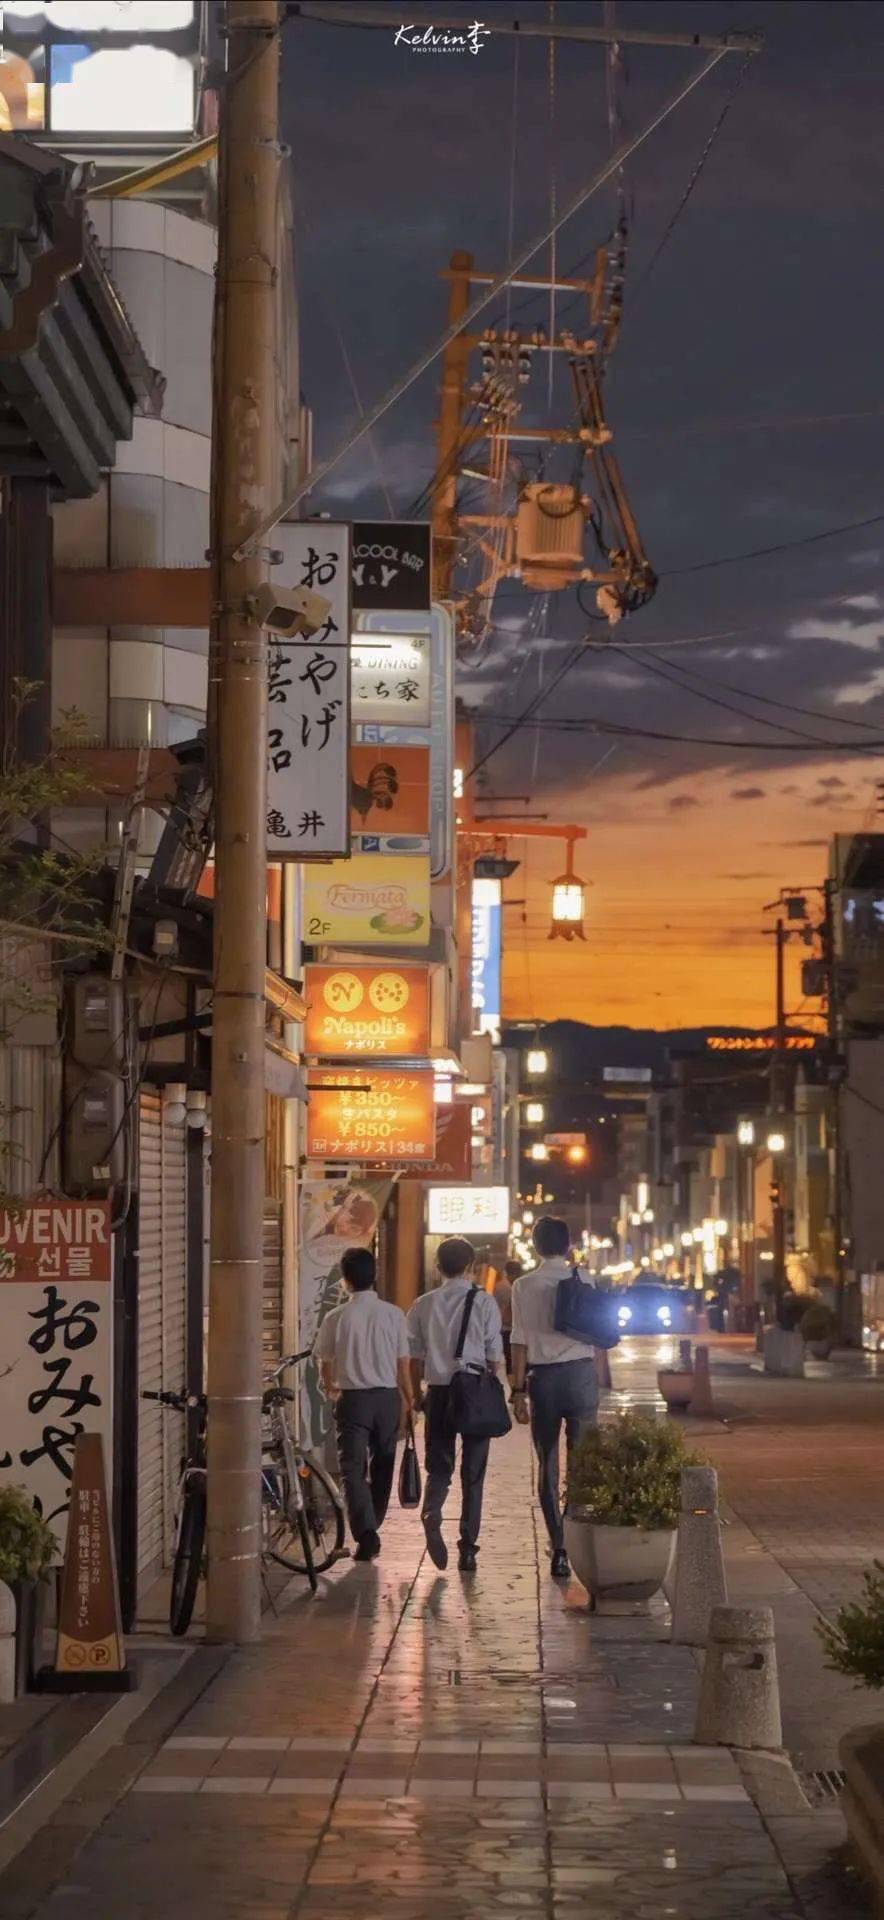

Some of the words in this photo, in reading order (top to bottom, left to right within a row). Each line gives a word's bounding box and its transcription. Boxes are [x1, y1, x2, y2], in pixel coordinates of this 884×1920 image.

[401, 551, 425, 572] BAR
[367, 656, 418, 670] DINING
[266, 806, 325, 839] 亀井
[309, 917, 332, 936] 2F
[323, 1016, 406, 1038] Napoli's
[344, 1039, 387, 1050] ナポリス
[341, 1108, 398, 1121] 生パスタ
[36, 1246, 94, 1278] 선물
